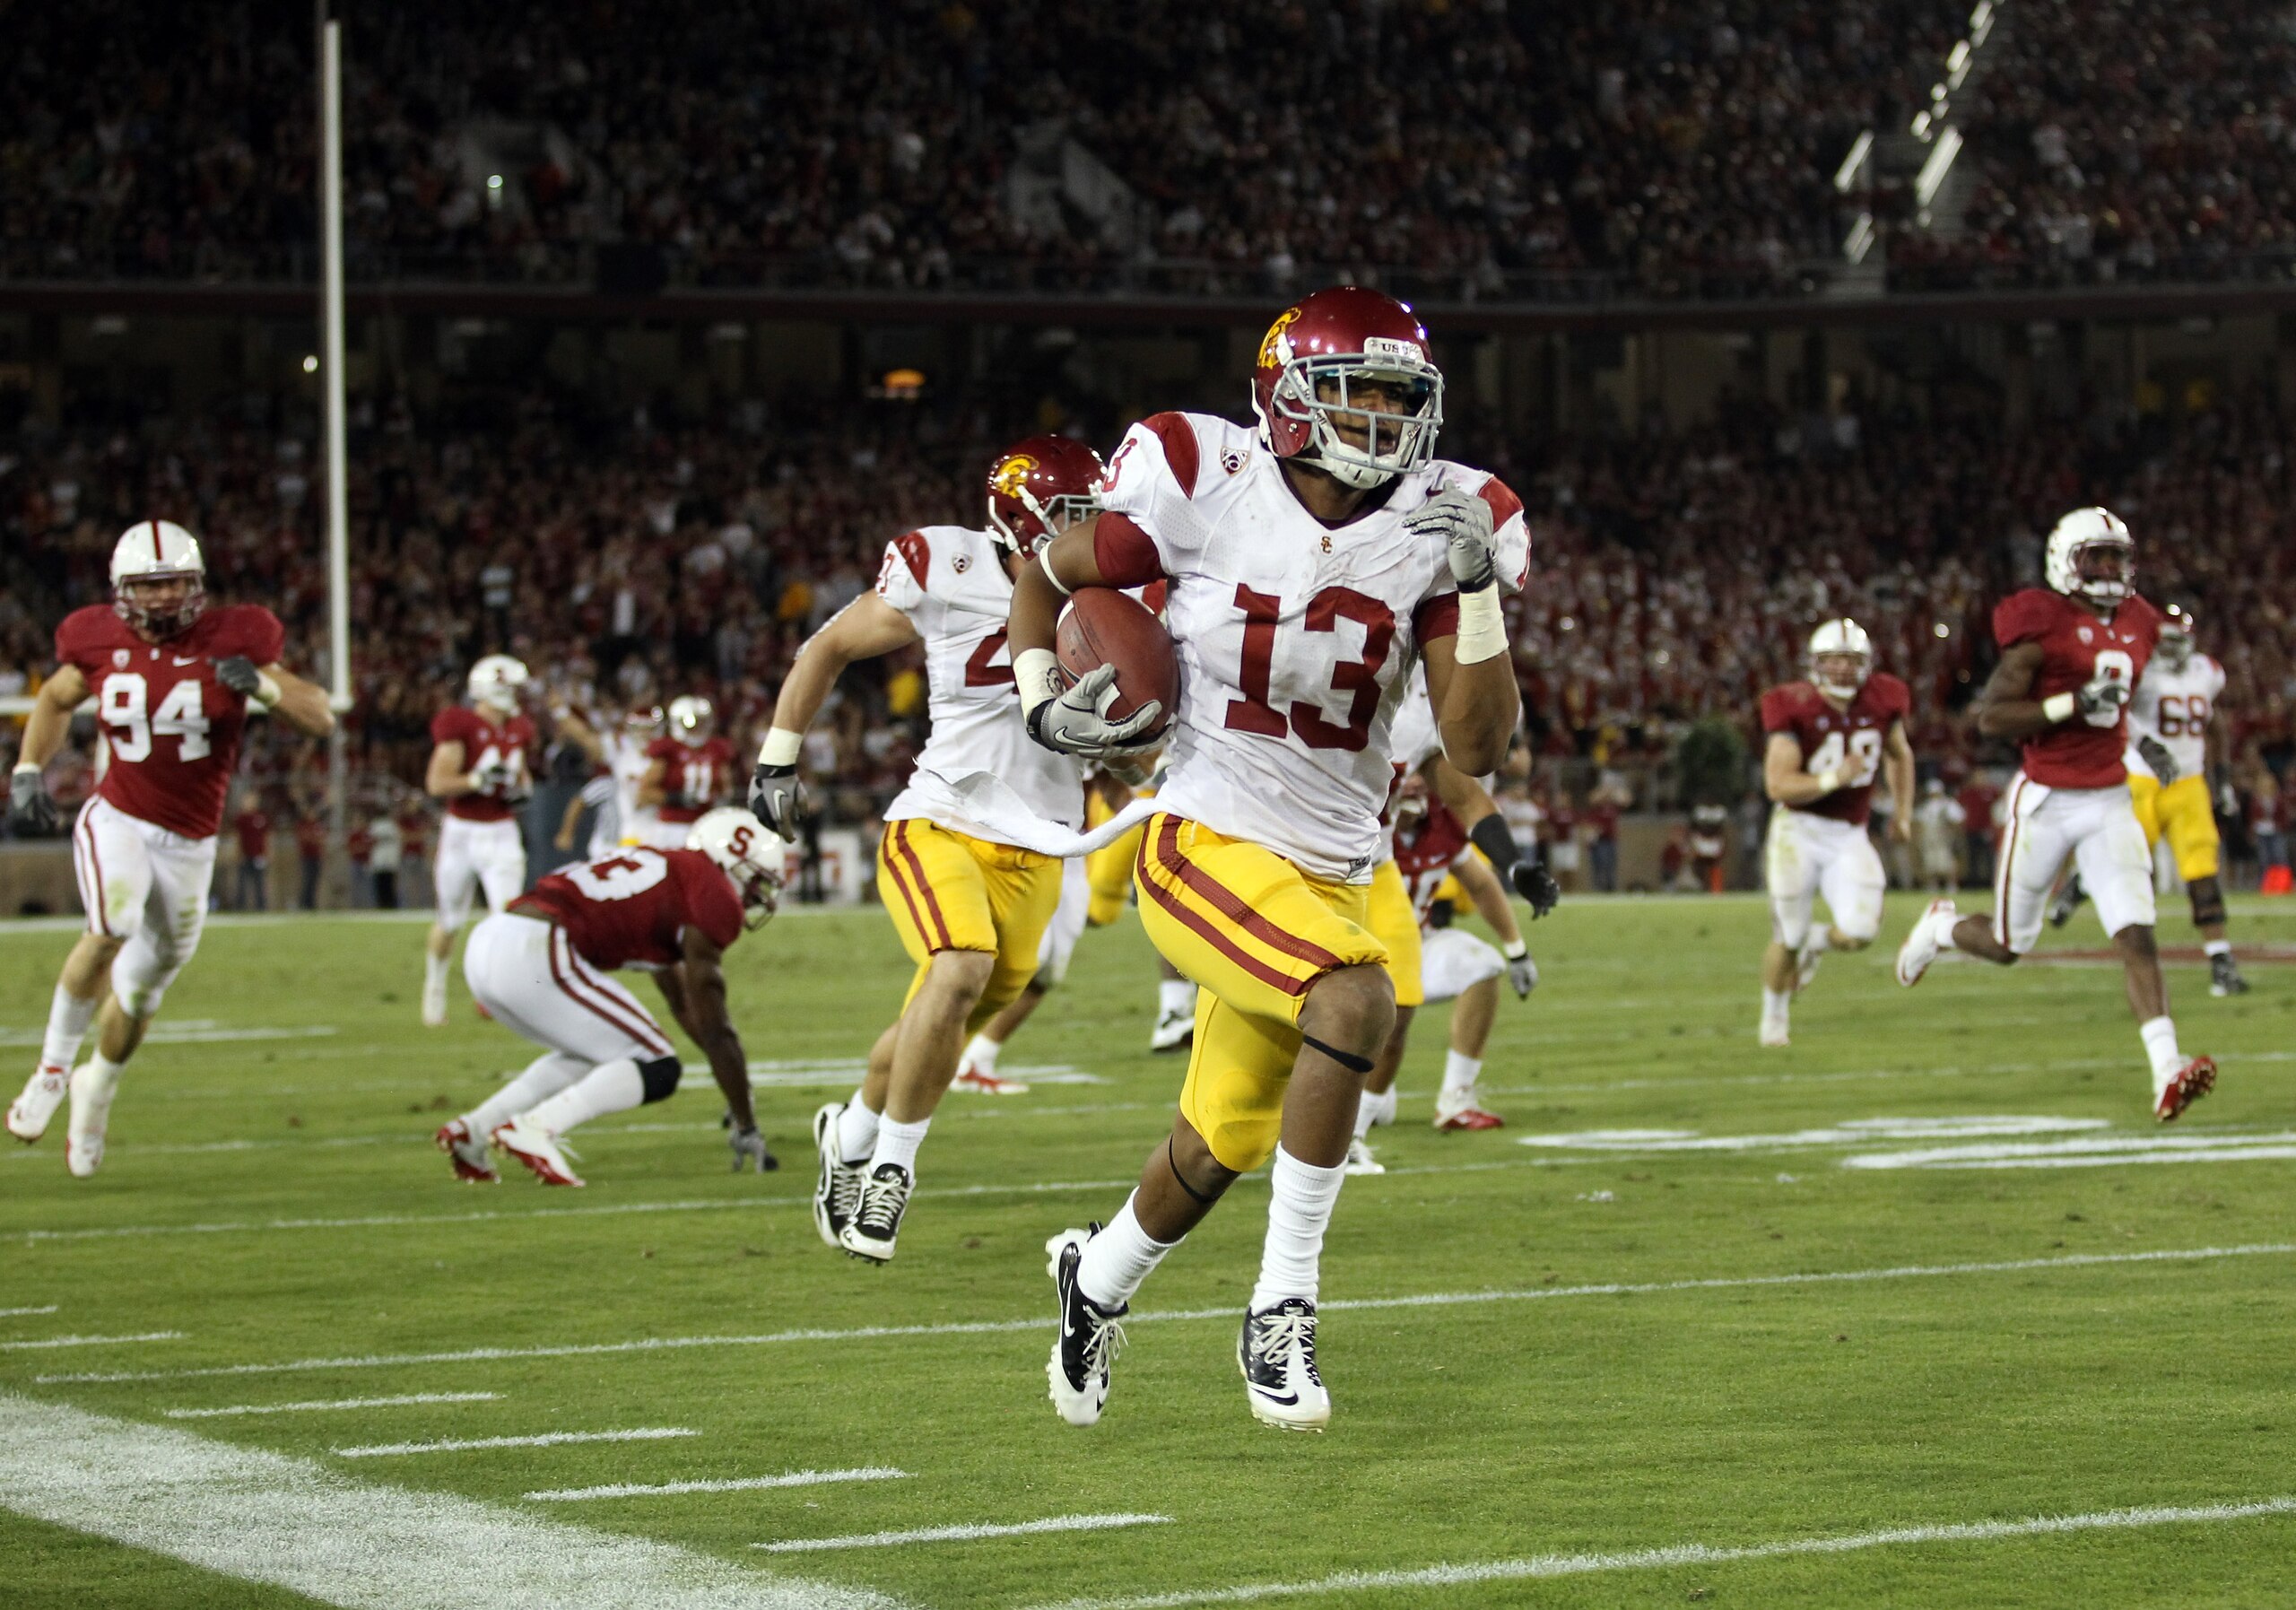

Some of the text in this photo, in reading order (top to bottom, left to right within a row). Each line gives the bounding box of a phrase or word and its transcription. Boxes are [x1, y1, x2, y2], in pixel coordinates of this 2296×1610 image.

[1224, 583, 1396, 752] 13
[100, 673, 212, 762] 94
[727, 826, 754, 856] S
